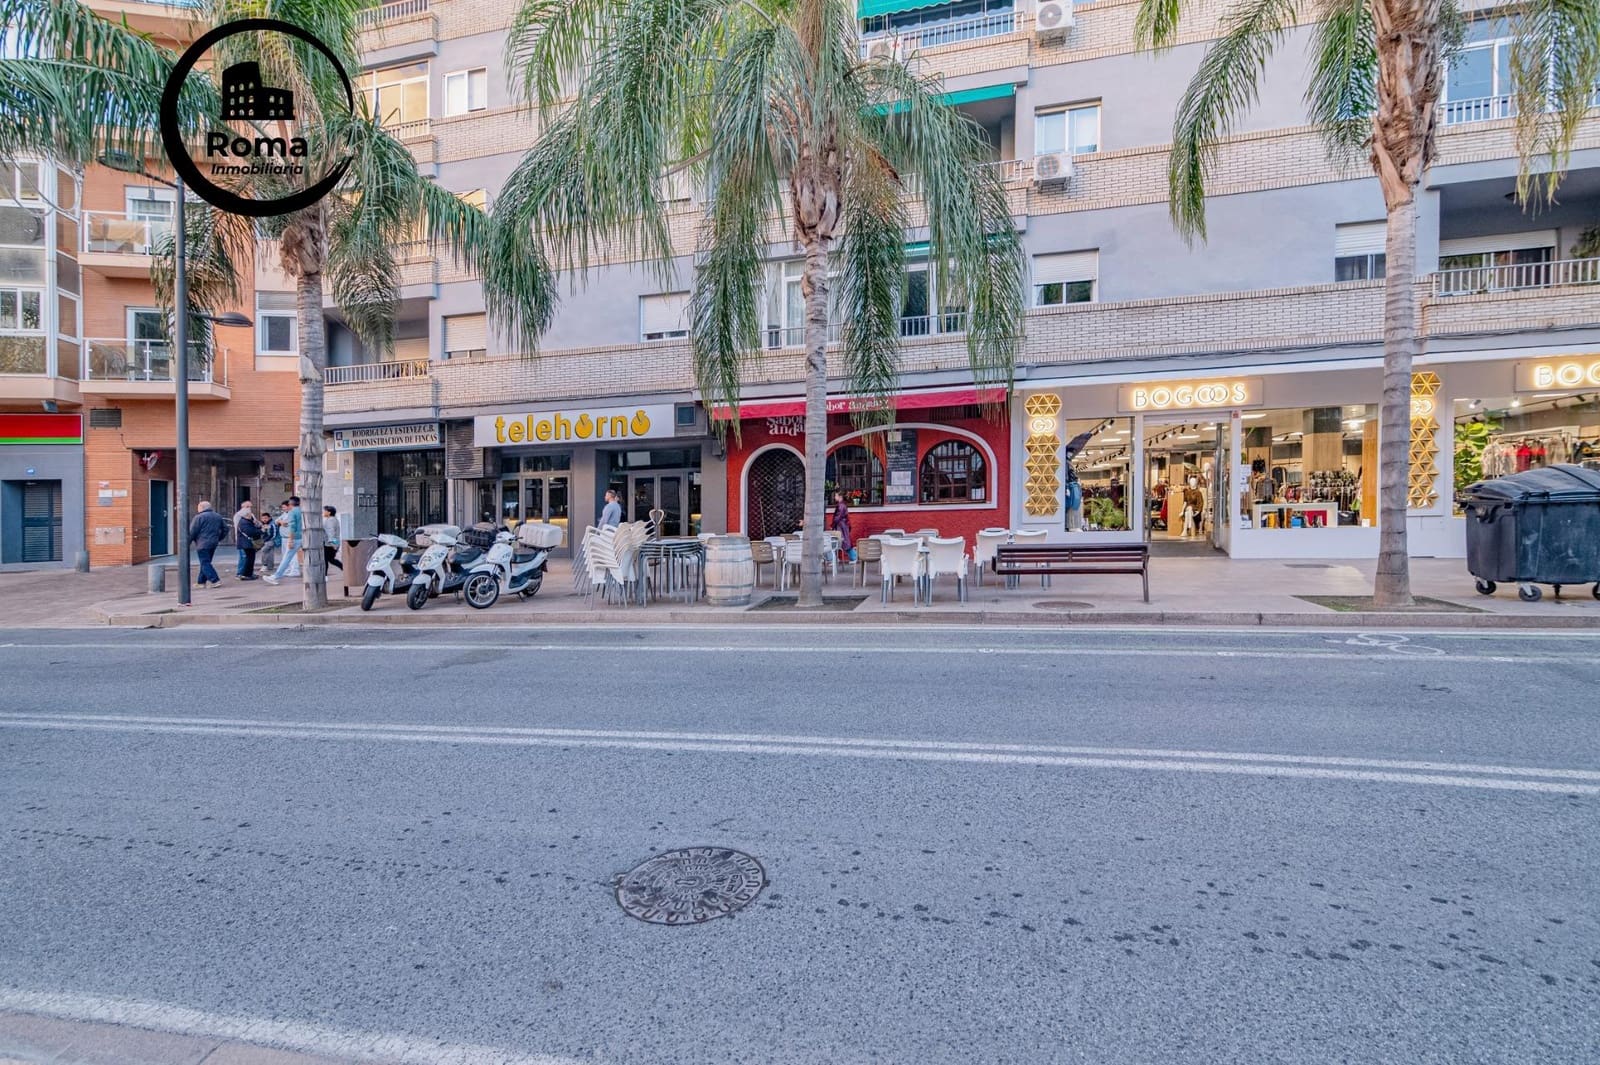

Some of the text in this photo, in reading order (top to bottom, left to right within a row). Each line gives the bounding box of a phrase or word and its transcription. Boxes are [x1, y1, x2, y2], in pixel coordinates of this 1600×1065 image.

[1135, 382, 1247, 408] BOGOOS
[405, 436, 413, 444] DE
[414, 433, 438, 443] FINCAS
[494, 409, 651, 443] telehorno
